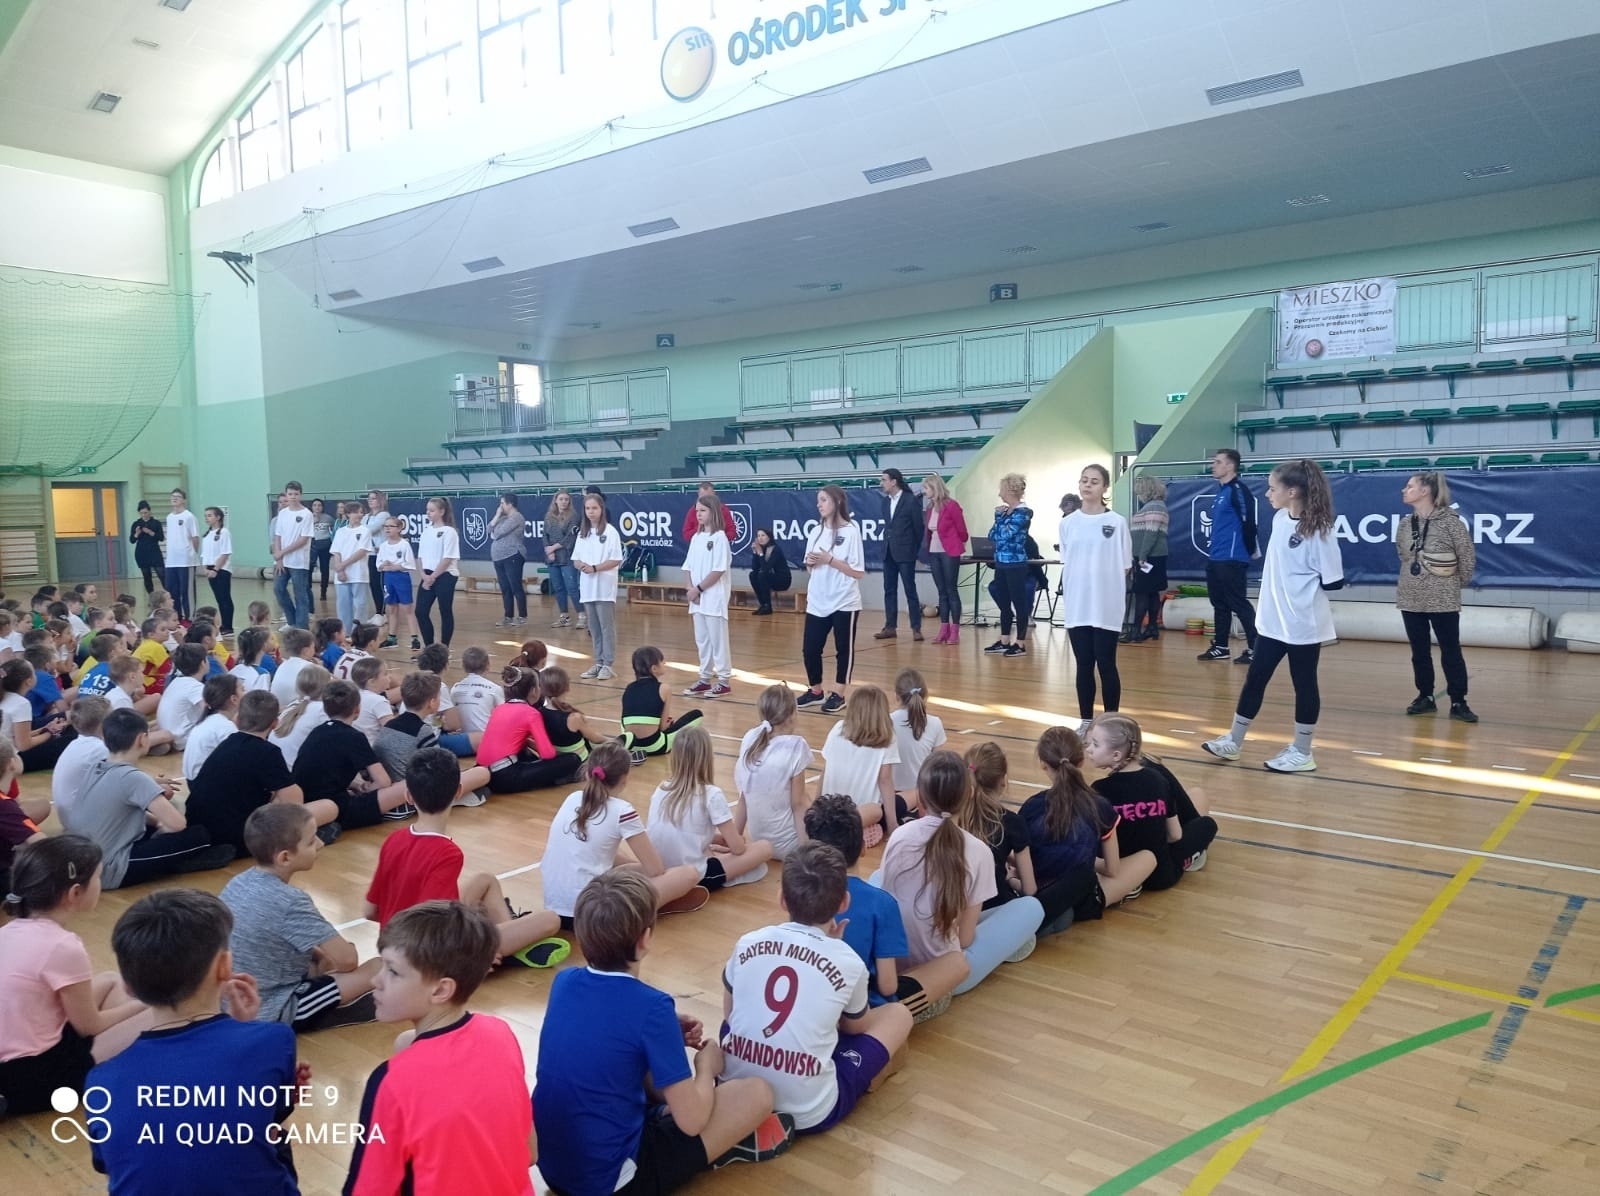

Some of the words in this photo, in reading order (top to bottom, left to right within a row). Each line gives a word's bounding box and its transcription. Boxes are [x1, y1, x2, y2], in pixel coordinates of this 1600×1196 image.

[727, 0, 868, 66] OŚRODEK
[1000, 288, 1013, 299] B
[1293, 282, 1382, 308] MIESZKO
[659, 338, 672, 346] A
[640, 537, 673, 547] RACIBÓRZ
[93, 674, 112, 689] 13
[738, 940, 784, 965] BAYERN
[785, 943, 847, 992] MÜNCHEN
[762, 965, 799, 1039] 9
